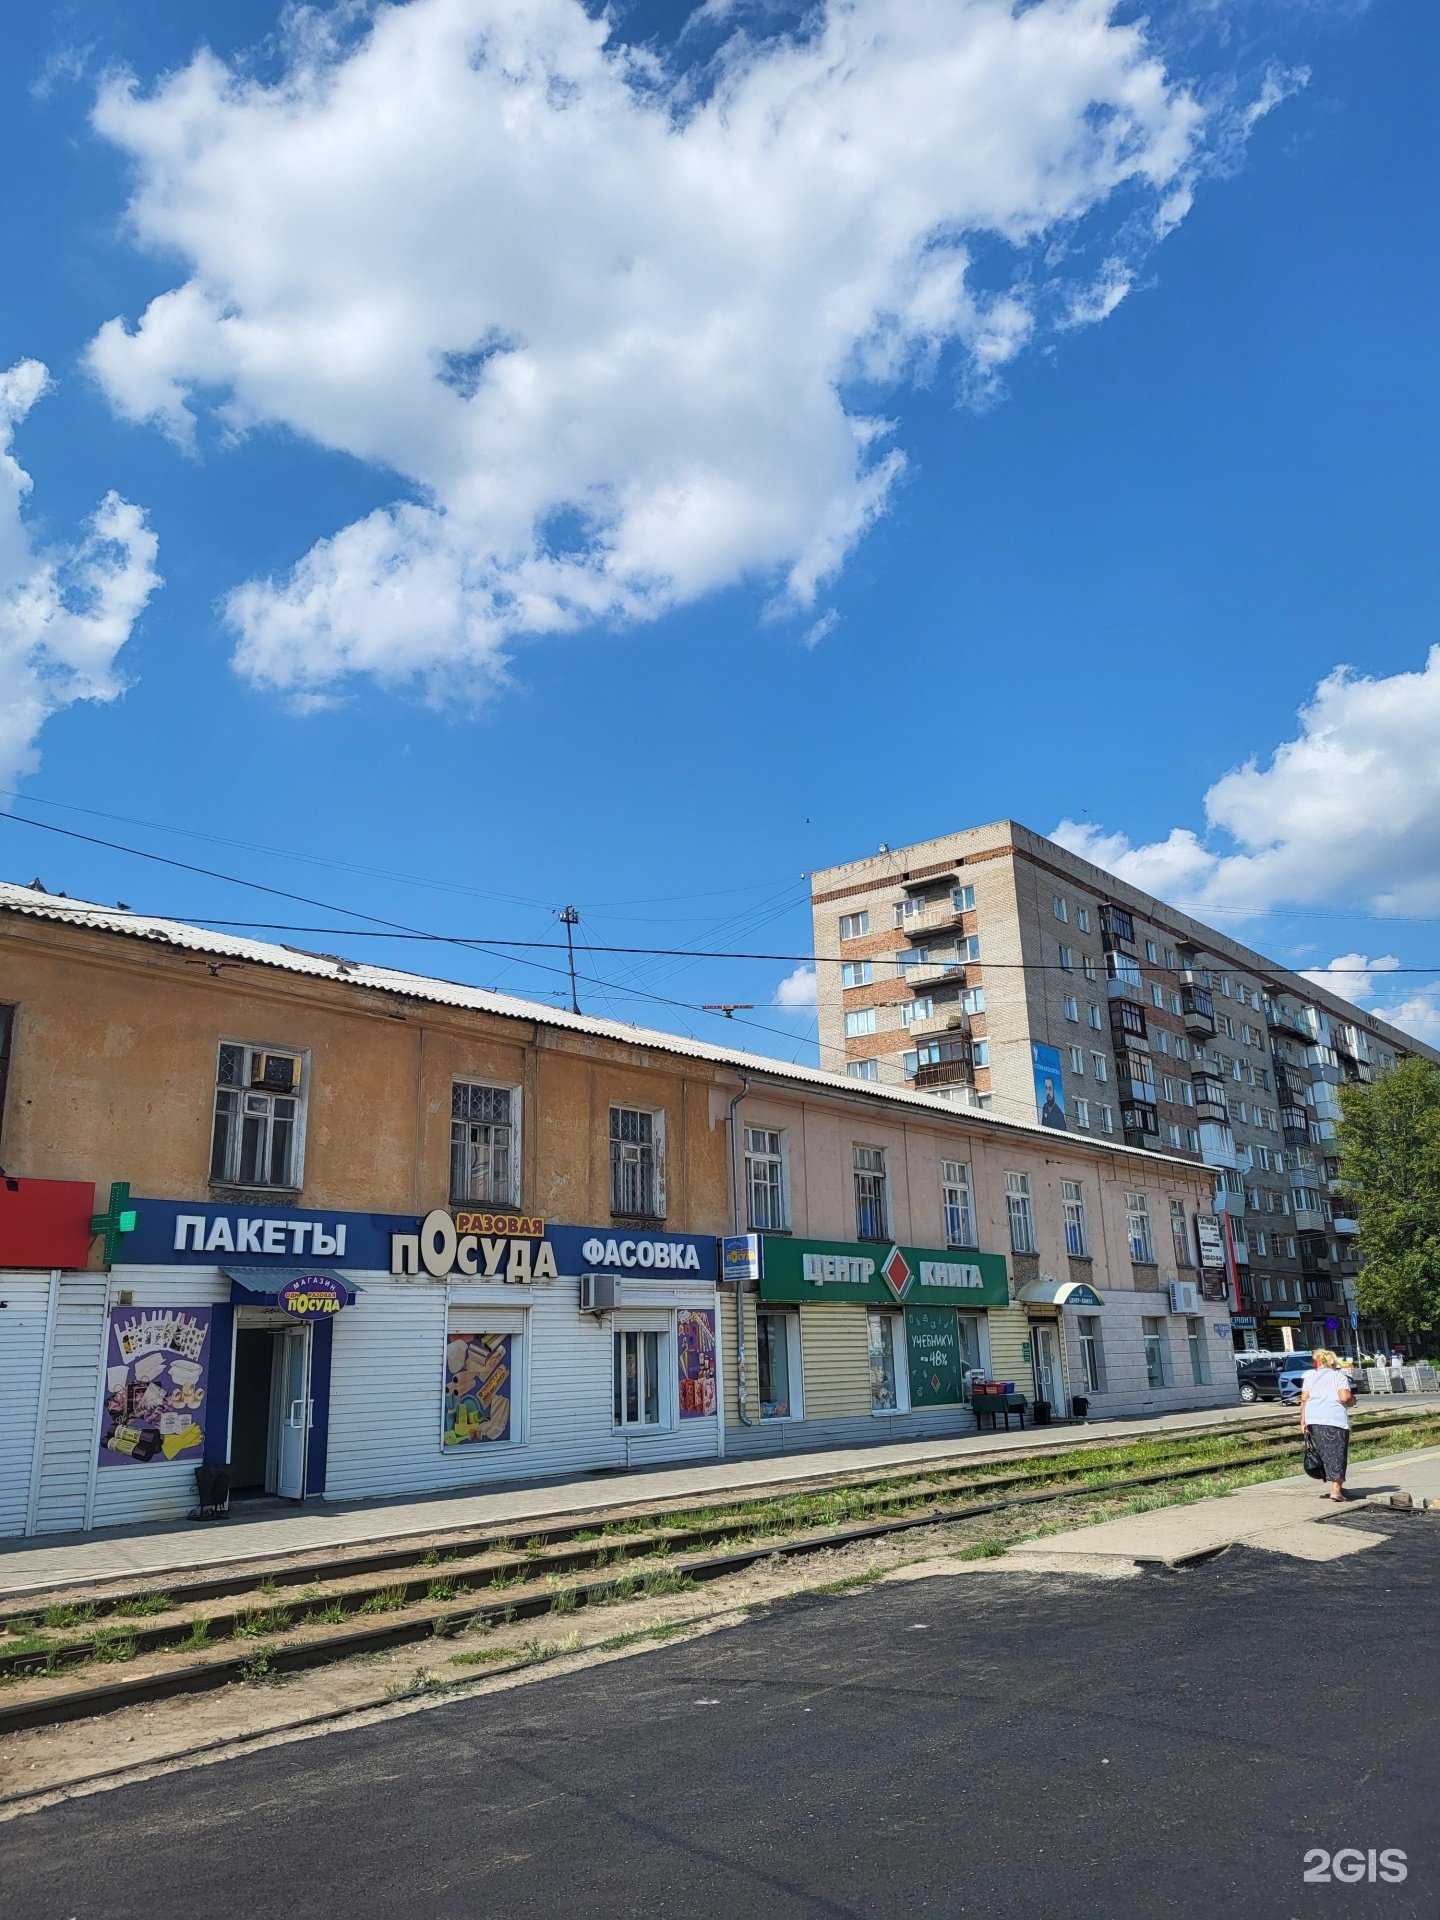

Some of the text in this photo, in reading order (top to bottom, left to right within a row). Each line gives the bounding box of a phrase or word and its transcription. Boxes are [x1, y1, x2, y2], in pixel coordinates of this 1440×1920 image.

[173, 1214, 347, 1257] ПАКЕТЫ
[457, 1213, 544, 1236] РАЗОВАЯ
[582, 1238, 701, 1270] ФАСОВКА
[293, 1276, 336, 1291] МАГАЗИН
[803, 1253, 984, 1289] ЦЕНТР КНИГА
[911, 1334, 954, 1348] УЧЕБНИКИ
